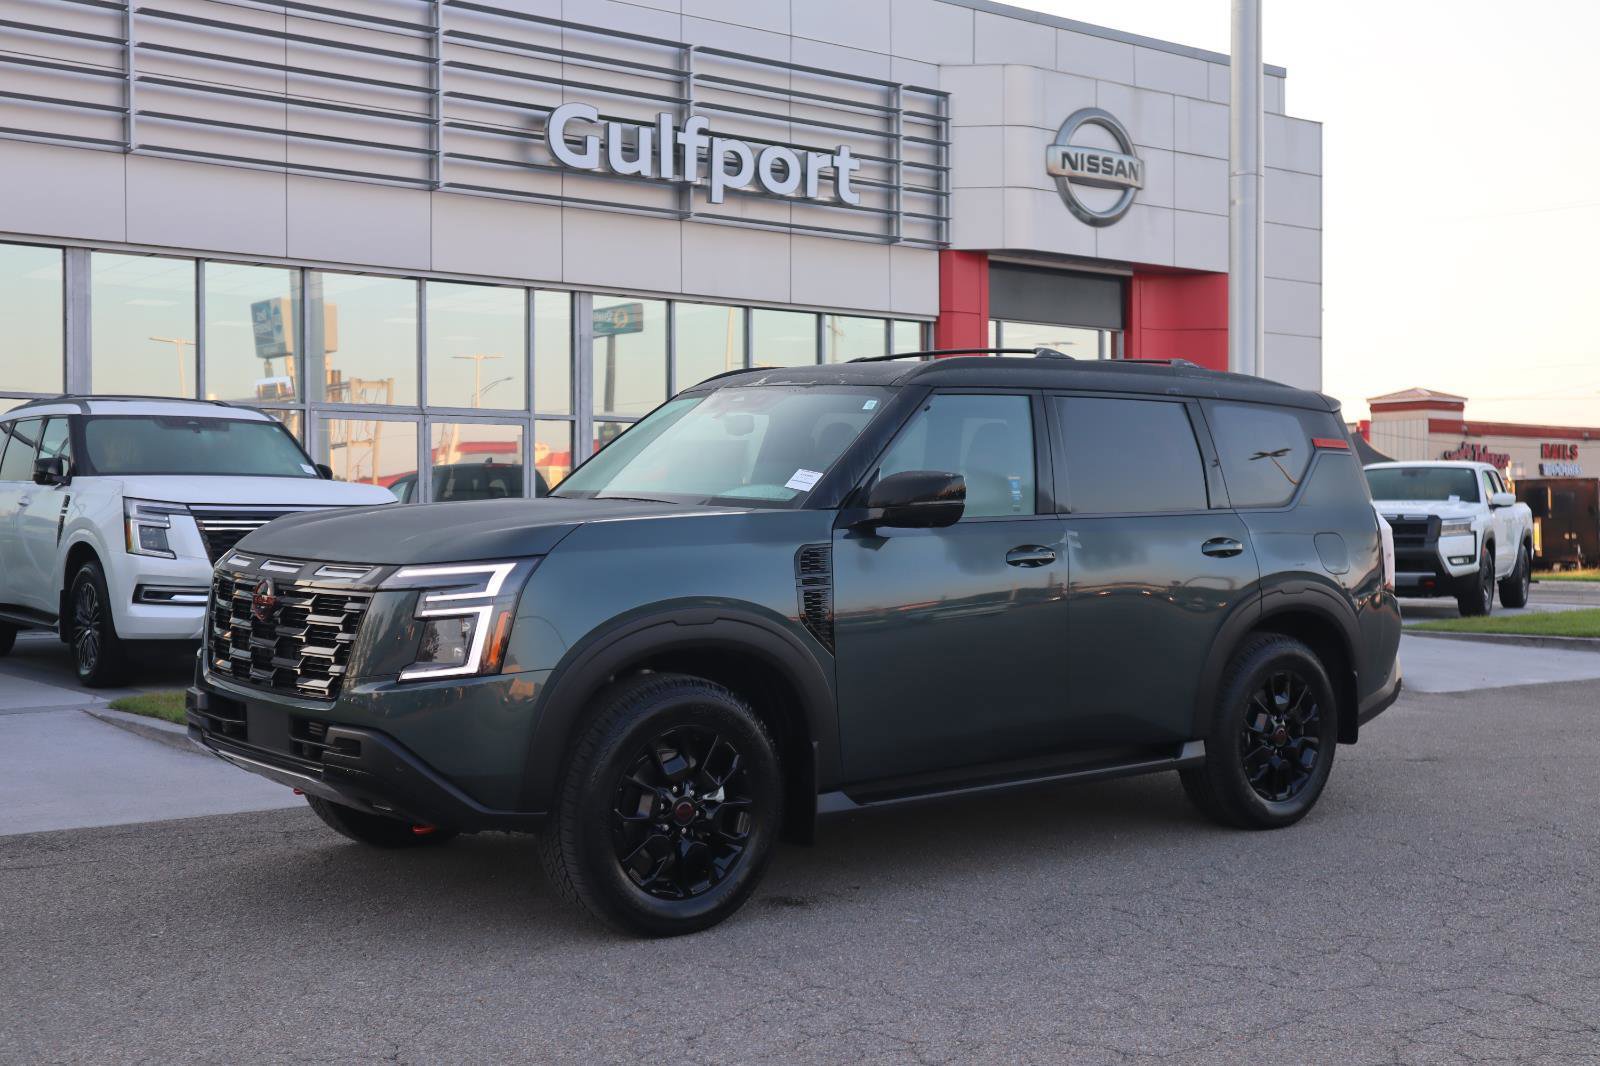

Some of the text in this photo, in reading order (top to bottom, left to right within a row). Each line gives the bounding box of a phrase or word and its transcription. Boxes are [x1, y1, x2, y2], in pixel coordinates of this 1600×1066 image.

[546, 102, 861, 204] Gulfport
[1061, 151, 1139, 181] NISSAN
[1541, 443, 1578, 460] NAILS
